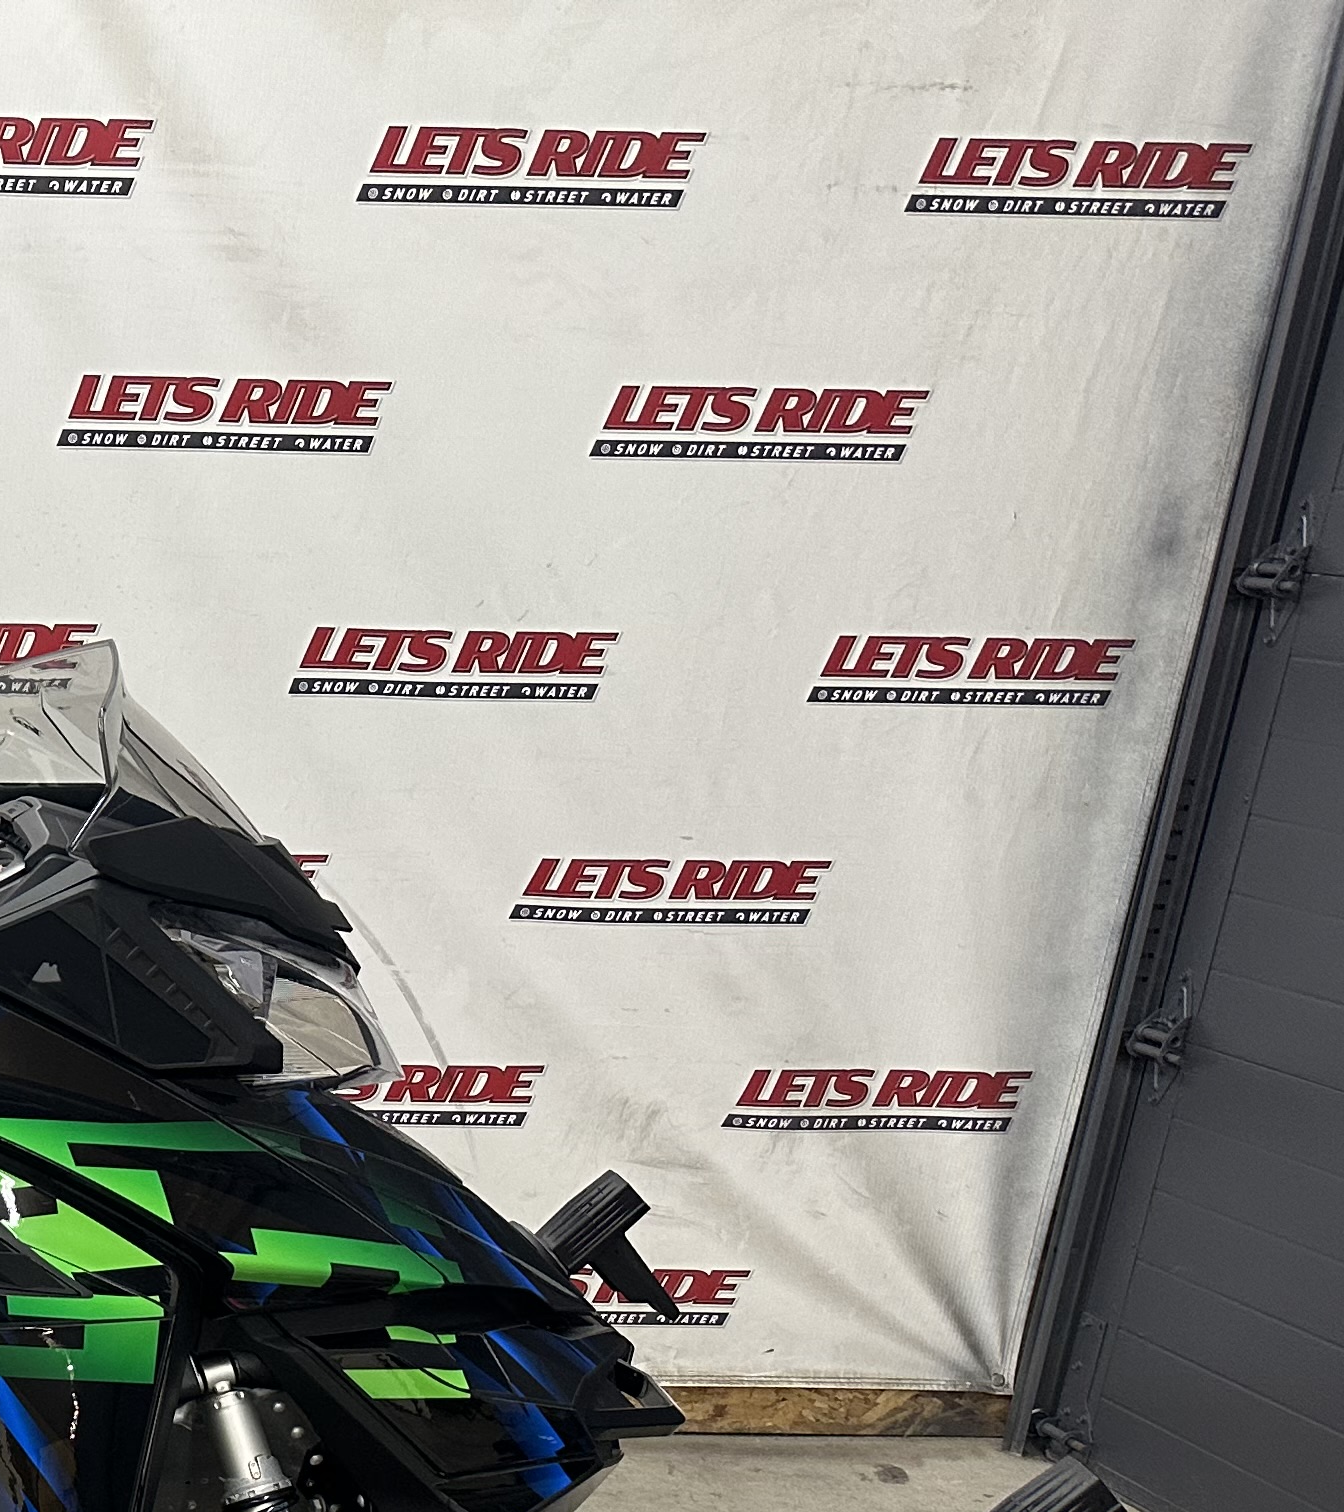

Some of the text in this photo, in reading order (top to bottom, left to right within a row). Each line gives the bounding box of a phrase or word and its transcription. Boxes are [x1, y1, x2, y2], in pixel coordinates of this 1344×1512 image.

[370, 126, 706, 179] LETS RIDE
[919, 138, 1252, 190] LETS RIDE
[63, 179, 123, 193] WATER
[381, 187, 673, 205] SNOW DIRT STREET WATER
[929, 198, 1215, 216] SNOW DIRT STREET WATER
[69, 375, 392, 426] LETS RIDE
[603, 386, 929, 434] LETS RIDE
[81, 432, 364, 450] SNOW DIRT STREET WATER
[300, 627, 618, 674] LETS RIDE
[821, 636, 1135, 681] LETS RIDE
[311, 680, 588, 698] SNOW DIRT STREET WATER
[523, 859, 832, 900] LETS RIDE
[384, 1065, 545, 1104] RIDE
[736, 1069, 1033, 1109] LETS RIDE
